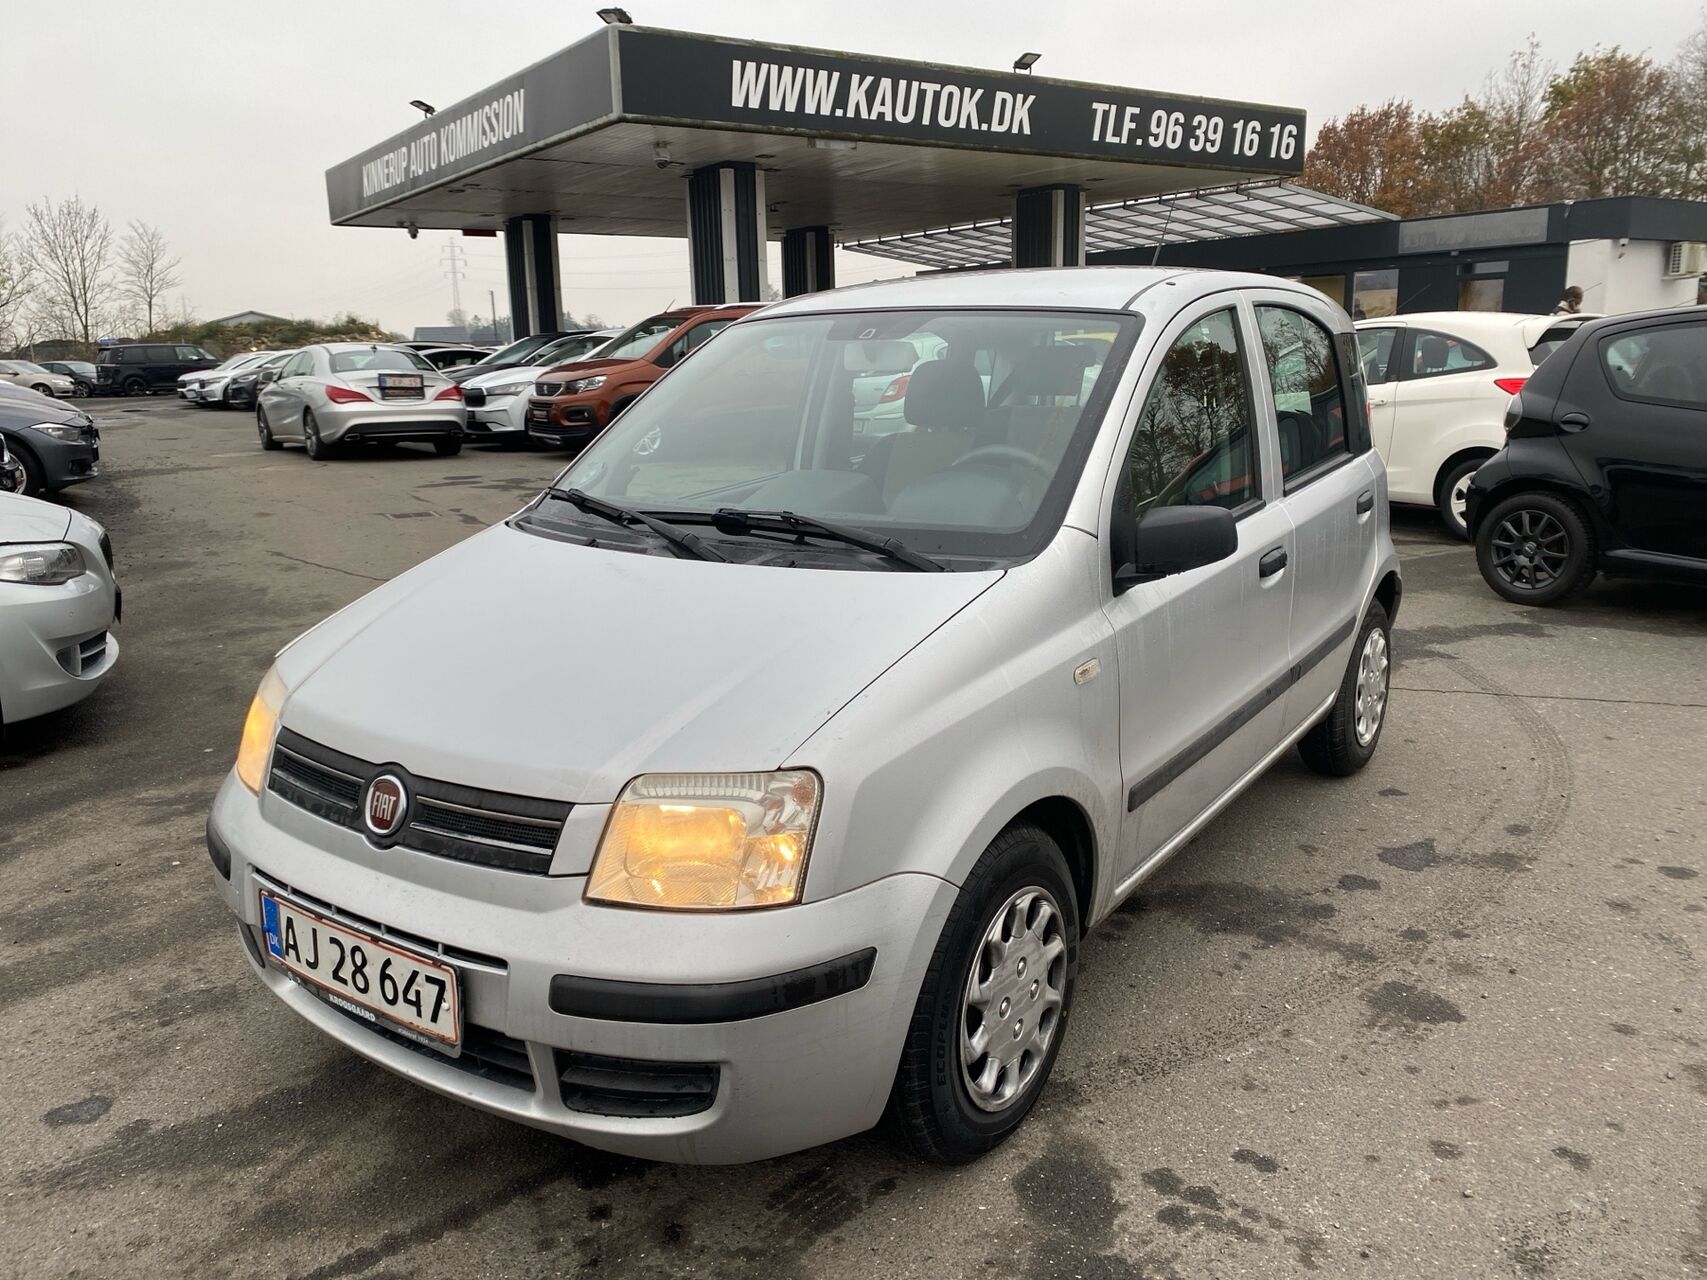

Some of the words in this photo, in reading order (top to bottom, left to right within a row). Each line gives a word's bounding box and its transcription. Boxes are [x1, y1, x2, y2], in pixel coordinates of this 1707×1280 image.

[731, 60, 1036, 135] WWW.KAUTOK.DK
[362, 147, 407, 198] KINNERUP
[409, 132, 437, 178] AUTO
[440, 88, 524, 166] KOMMISSION
[1091, 102, 1143, 146] TLF.
[1149, 109, 1185, 150] 96
[1189, 114, 1224, 154] 39
[1232, 119, 1261, 157] 16
[1269, 123, 1298, 160] 16
[371, 791, 397, 821] FIAT
[269, 932, 281, 949] DK
[284, 916, 319, 970] AJ
[329, 936, 370, 994] 28
[379, 958, 446, 1024] 647
